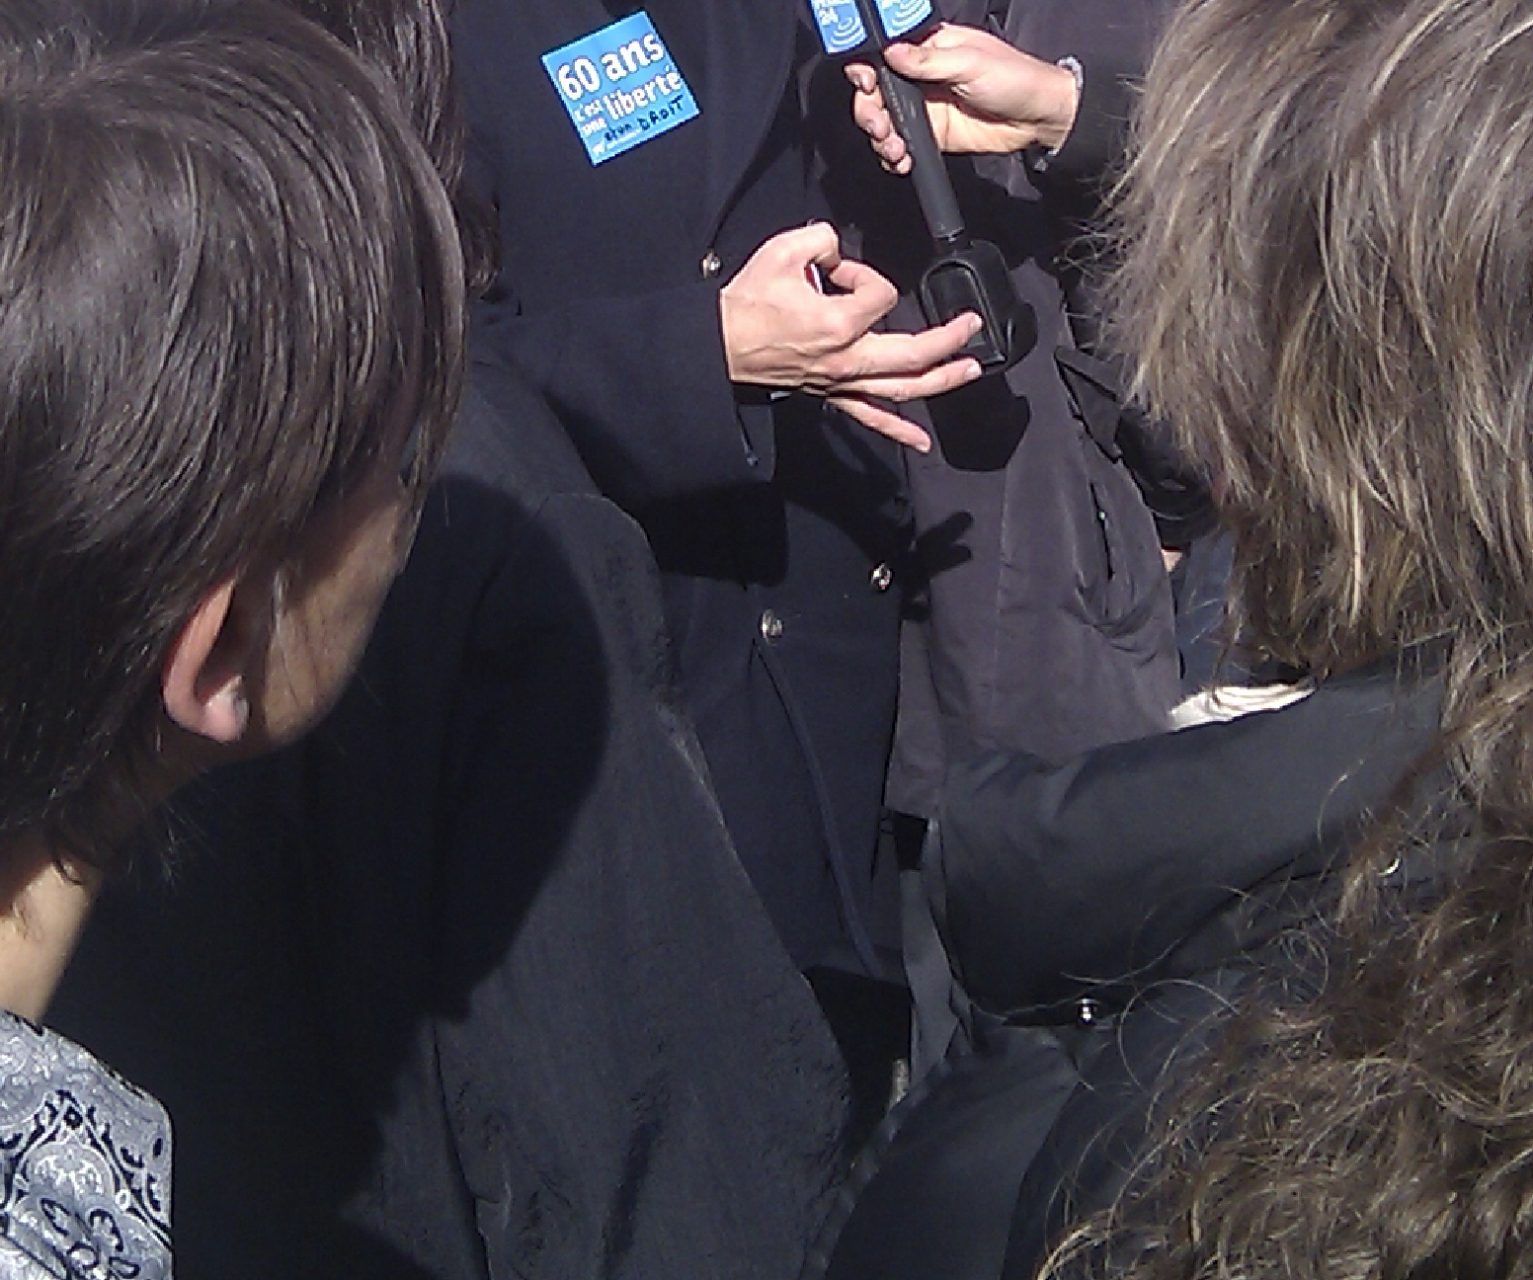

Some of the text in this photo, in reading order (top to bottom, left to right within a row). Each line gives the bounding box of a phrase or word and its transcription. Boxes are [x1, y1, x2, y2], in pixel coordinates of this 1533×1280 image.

[557, 33, 664, 101] 60 ans
[602, 65, 681, 120] liberté
